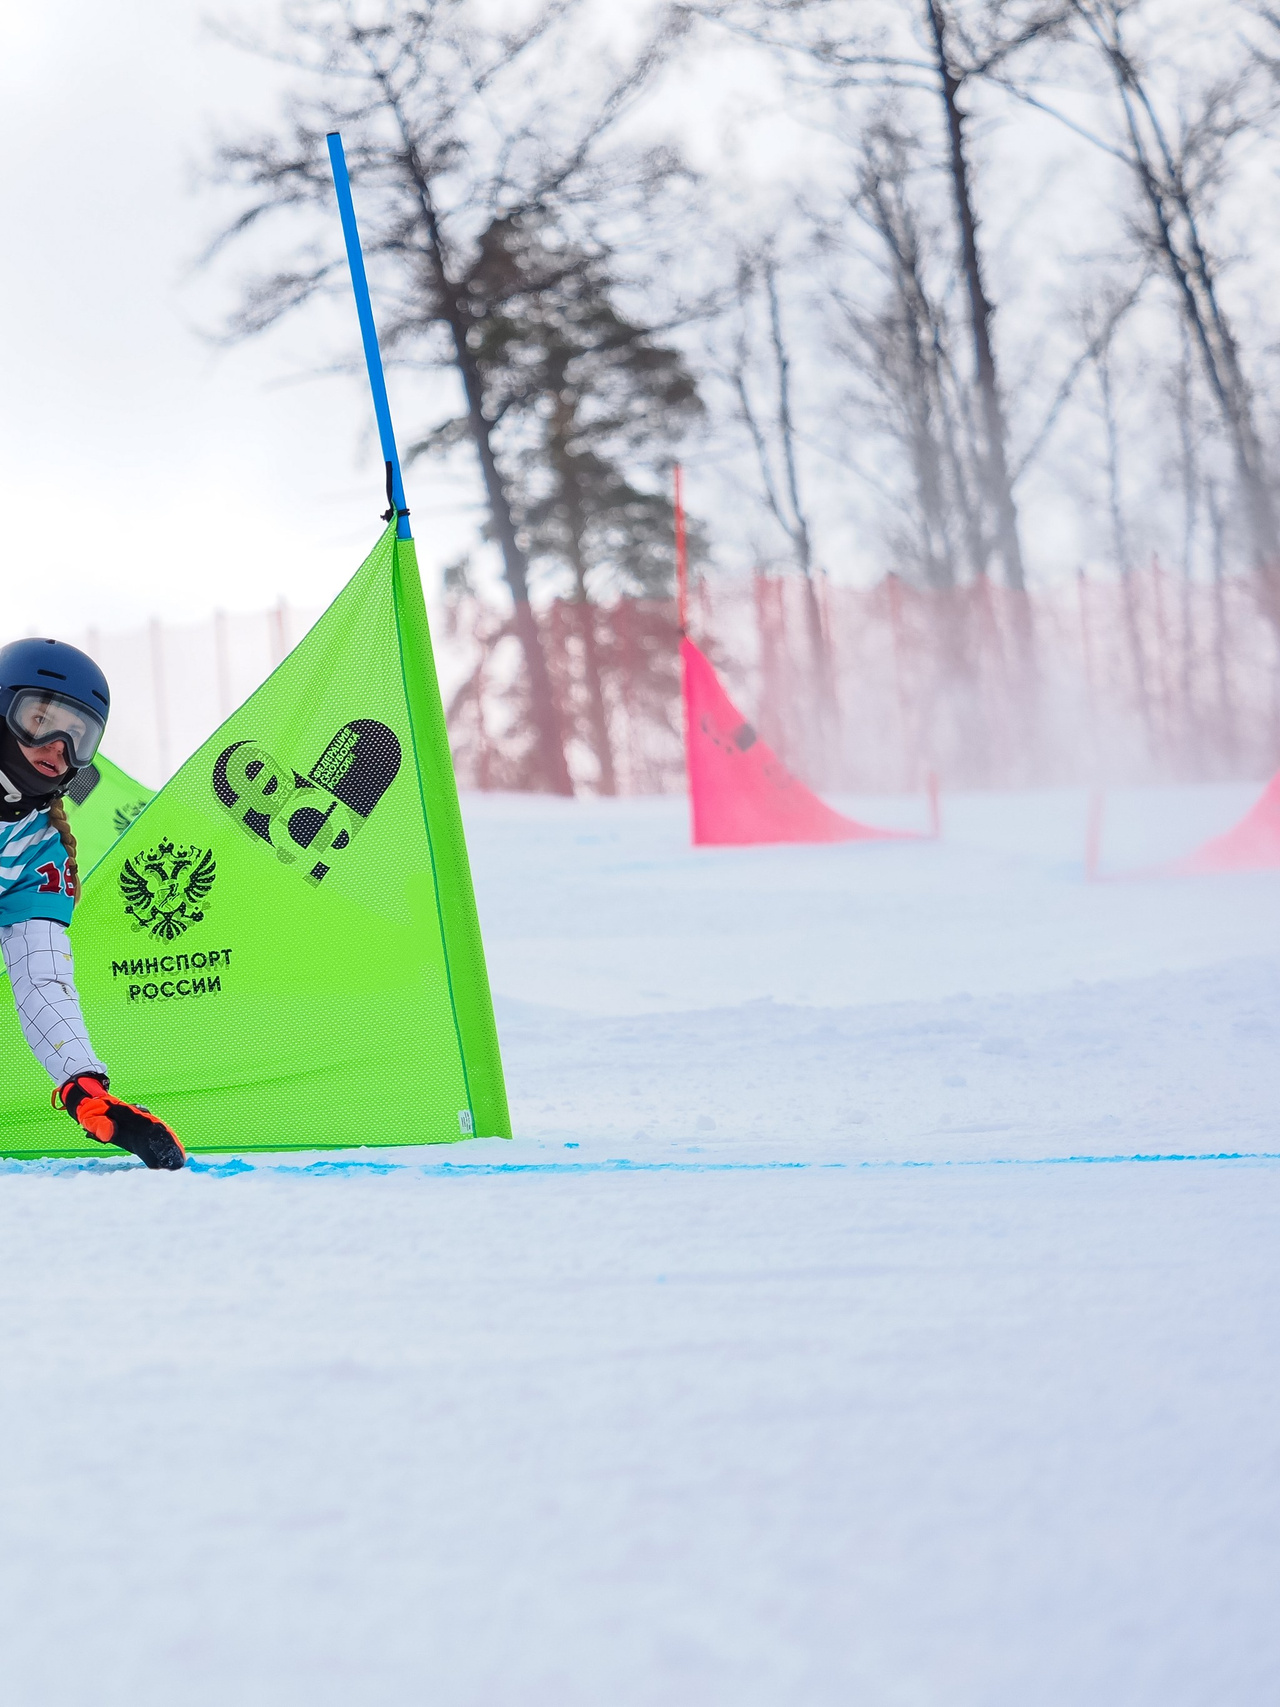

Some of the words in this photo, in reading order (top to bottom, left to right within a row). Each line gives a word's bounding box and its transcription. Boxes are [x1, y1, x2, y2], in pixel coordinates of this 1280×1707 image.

[313, 727, 352, 779] ФЕДЕРАЦИЯ
[320, 732, 360, 784] СНОУБОРДА
[326, 753, 357, 790] РОССИИ
[111, 949, 232, 977] МИНСПОРТ
[128, 976, 222, 1000] РОССИИ
